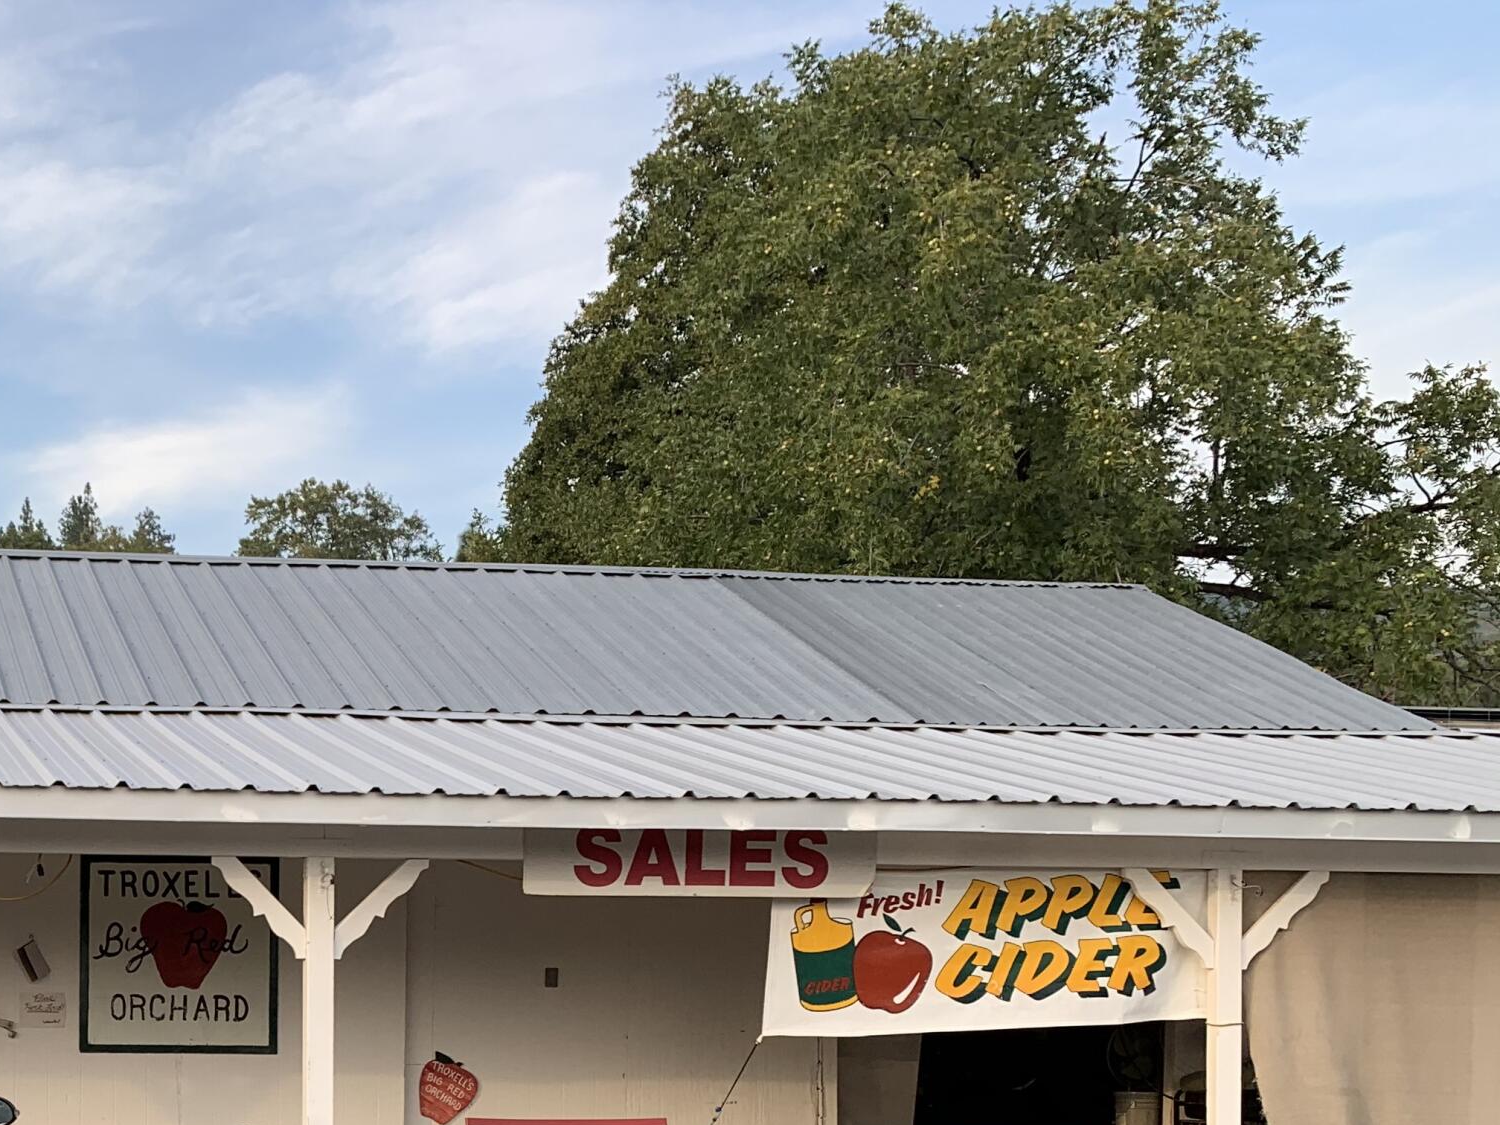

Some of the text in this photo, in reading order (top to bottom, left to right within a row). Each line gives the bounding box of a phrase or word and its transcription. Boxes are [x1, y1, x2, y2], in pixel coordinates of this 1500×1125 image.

[573, 828, 830, 889] SALES
[97, 869, 262, 899] TROXEL
[857, 879, 945, 919] Fresh!
[92, 921, 249, 974] Big Red
[934, 934, 1167, 1004] CIDER
[803, 976, 851, 996] CIDER
[110, 994, 250, 1022] ORCHARD
[426, 1072, 465, 1099] BIG RED
[432, 1060, 475, 1092] TROXELL'S
[424, 1084, 462, 1111] ORCHARD
